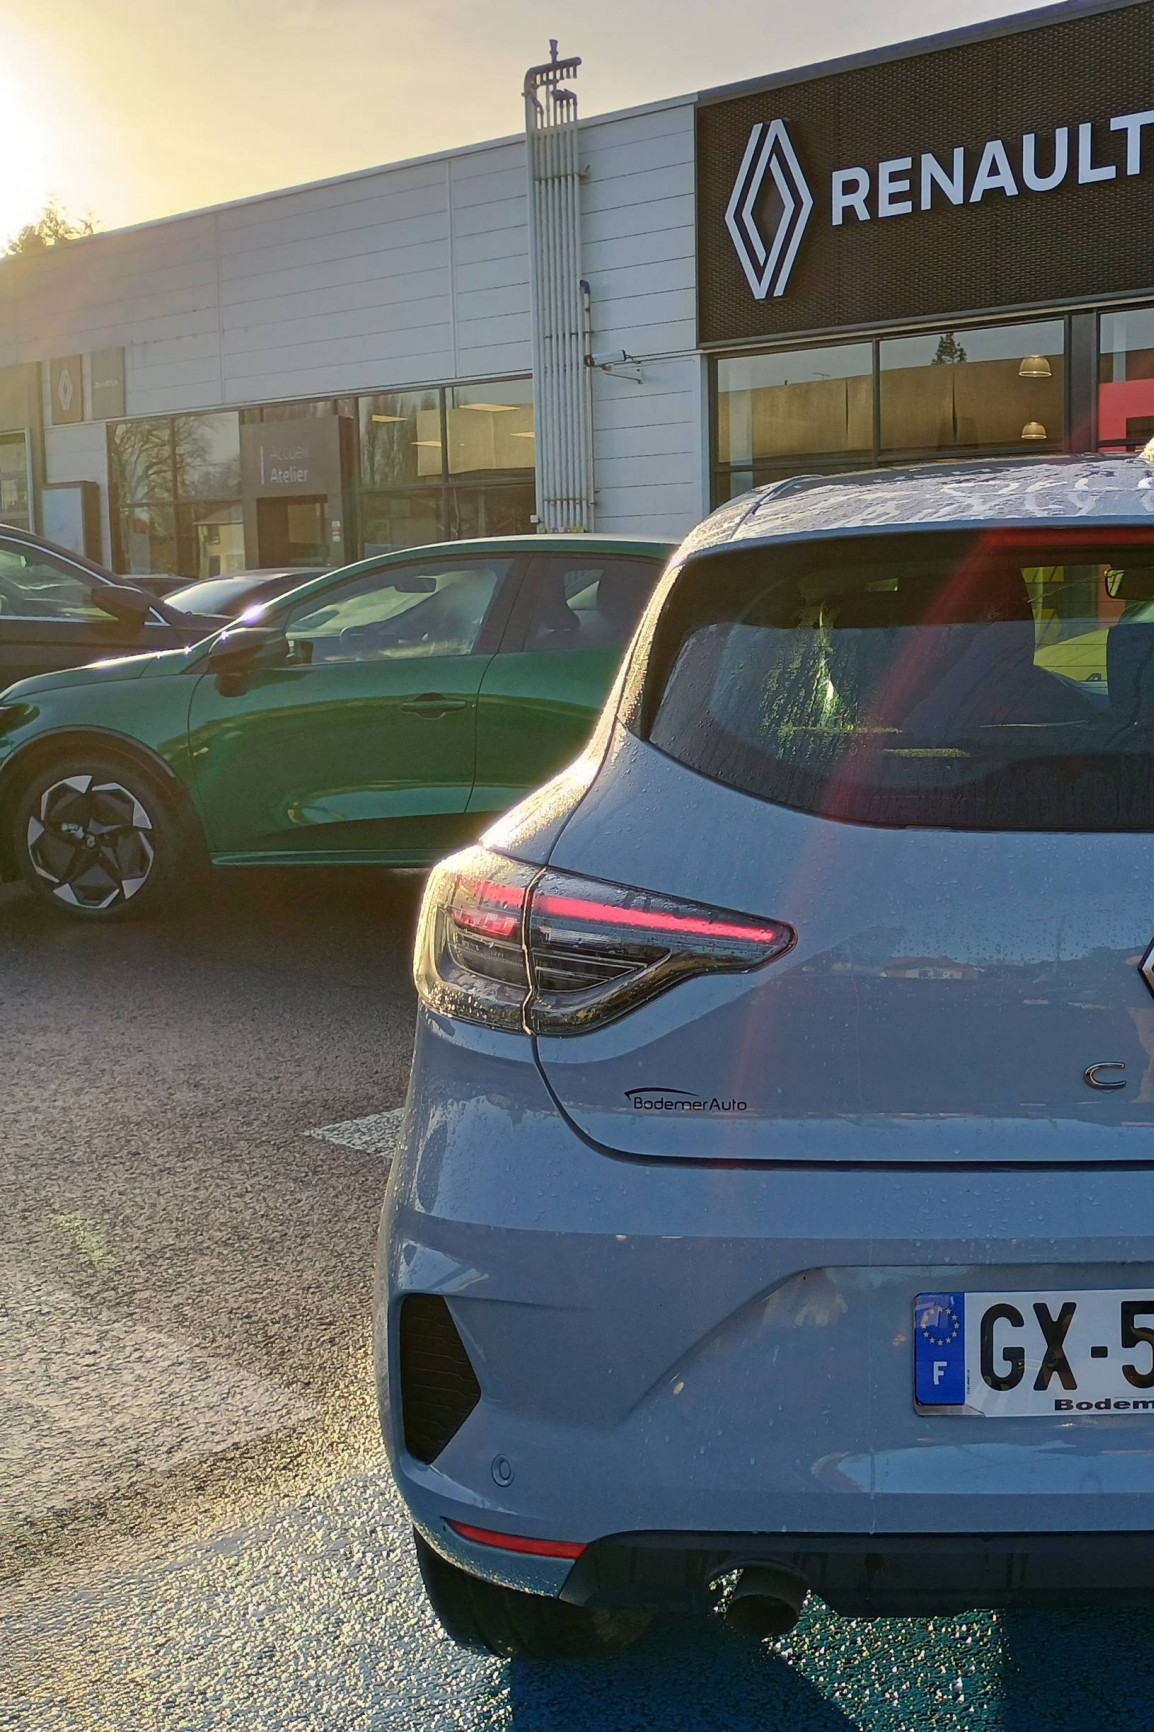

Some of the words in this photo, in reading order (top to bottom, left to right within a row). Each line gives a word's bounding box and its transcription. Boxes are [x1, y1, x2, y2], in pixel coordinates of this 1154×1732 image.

[269, 465, 310, 483] Atelier
[633, 1097, 748, 1111] BodemerAuto
[932, 1361, 948, 1385] F
